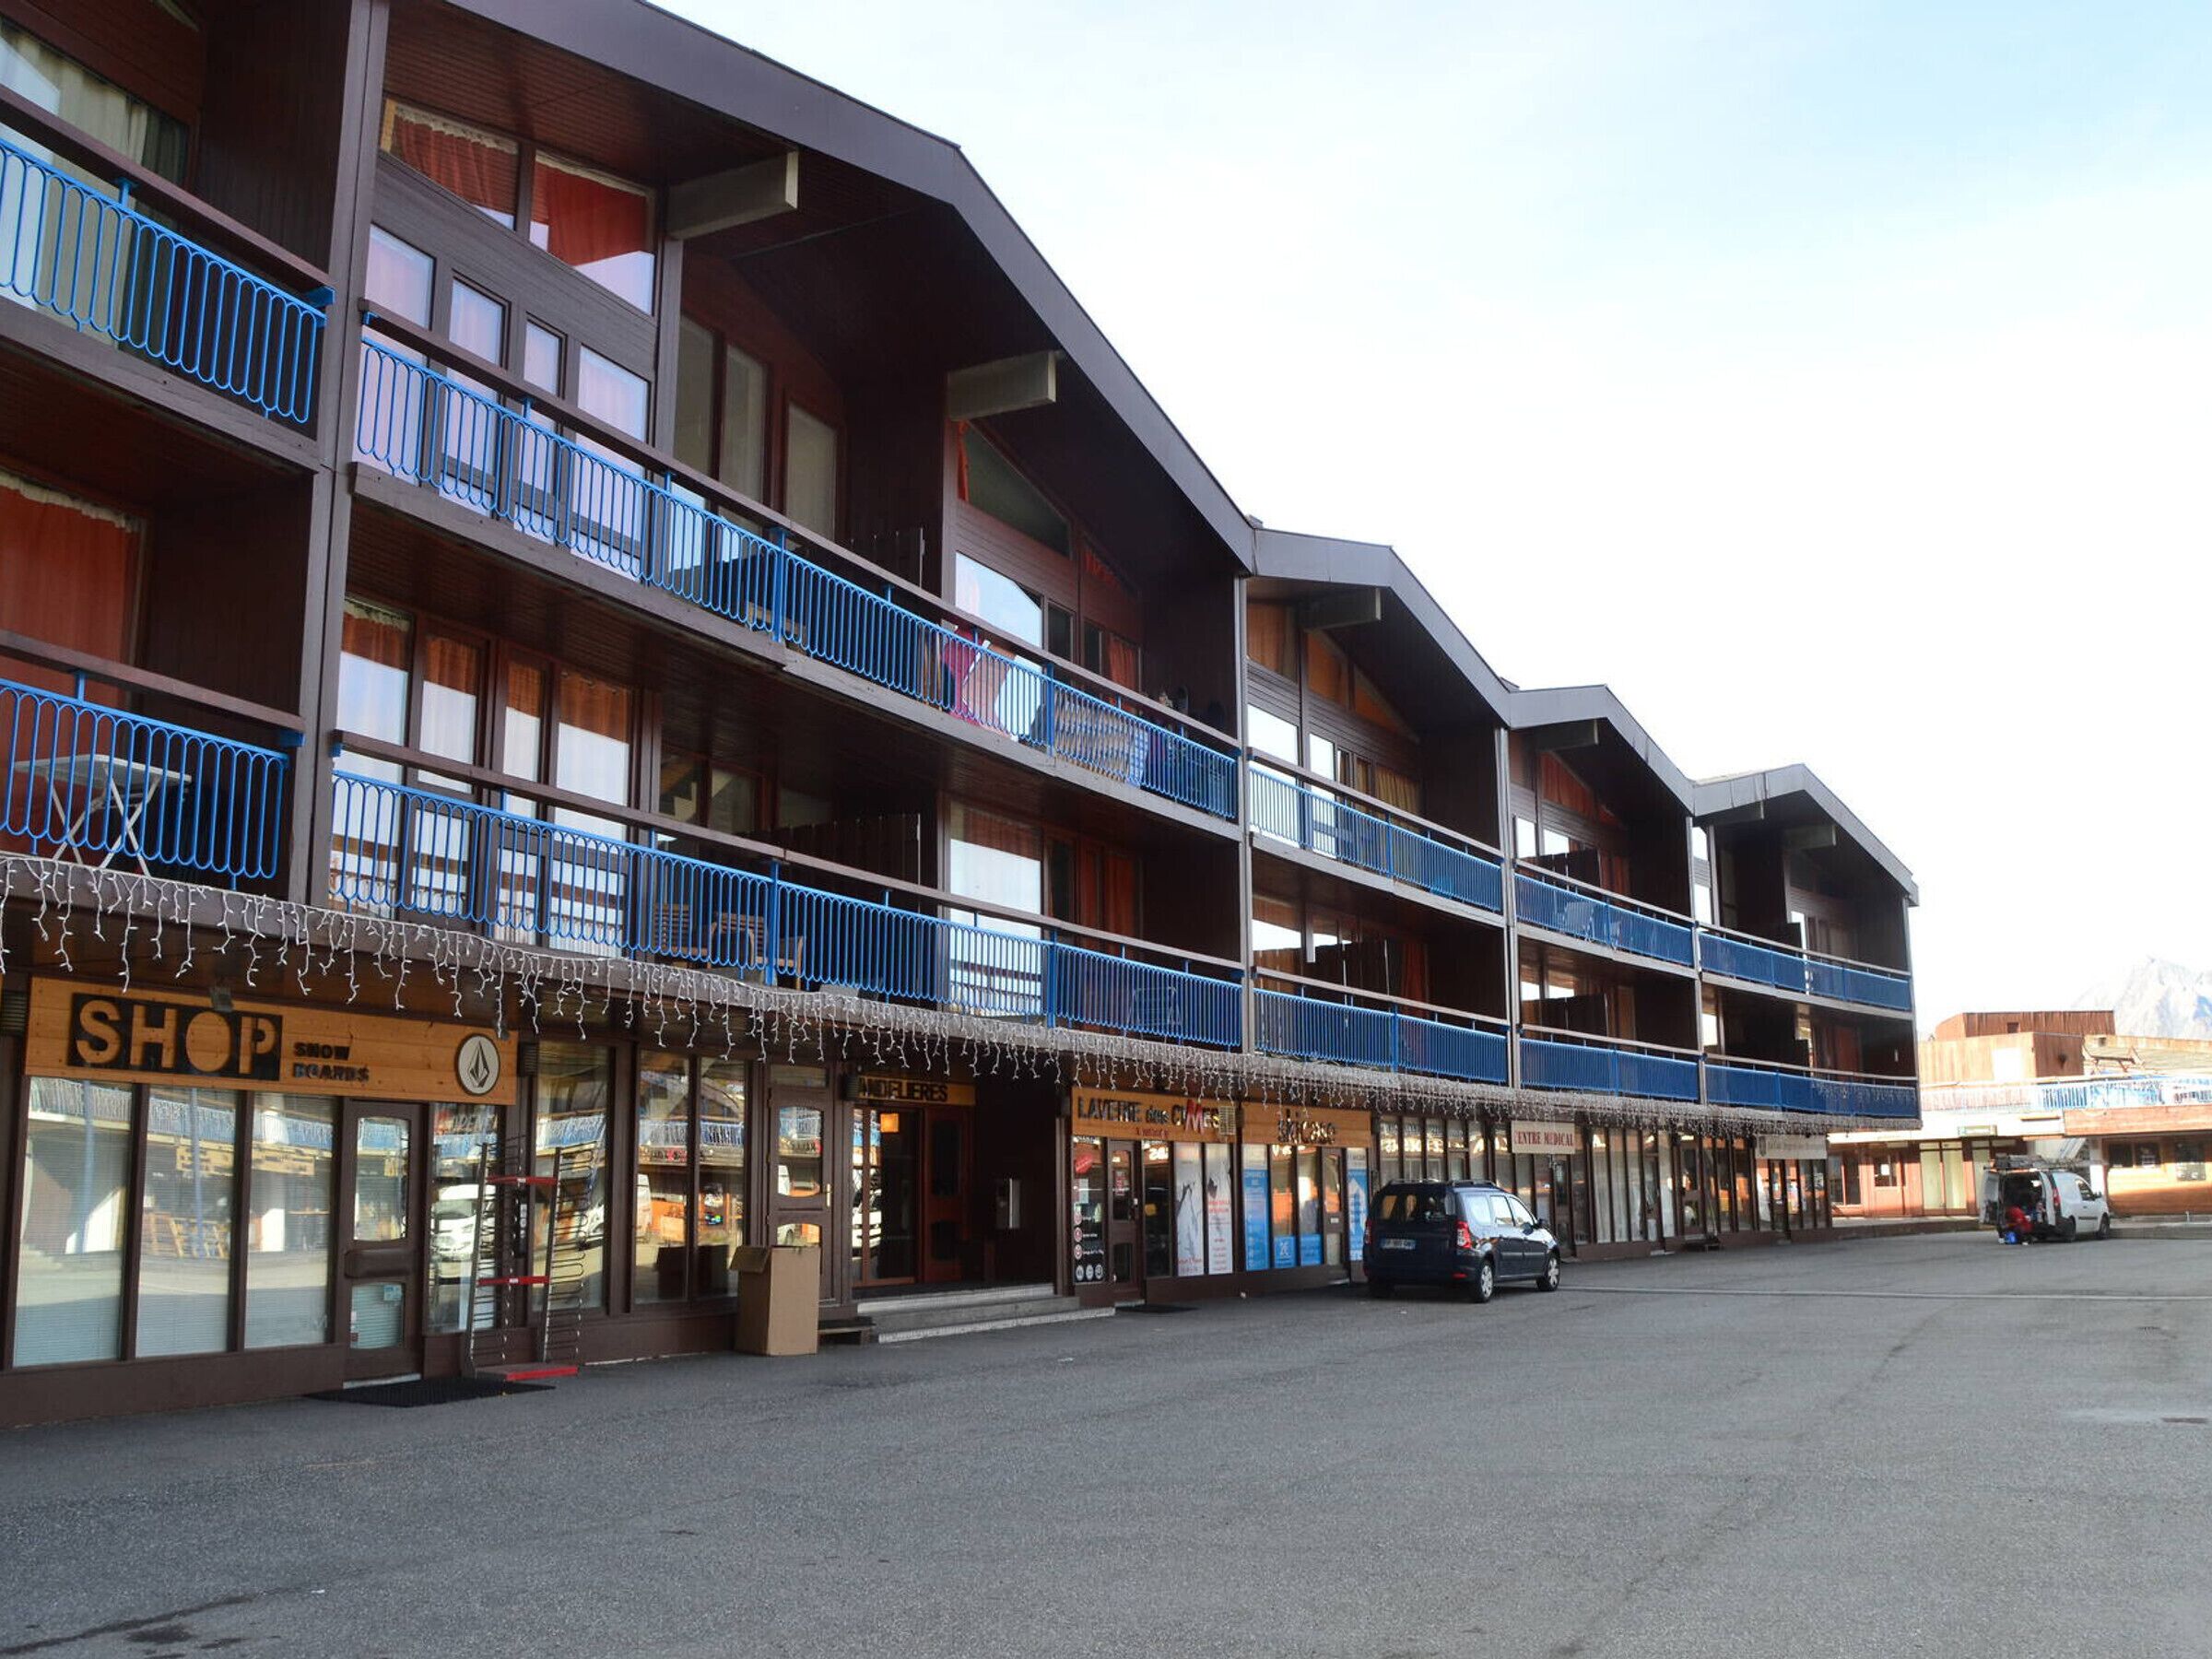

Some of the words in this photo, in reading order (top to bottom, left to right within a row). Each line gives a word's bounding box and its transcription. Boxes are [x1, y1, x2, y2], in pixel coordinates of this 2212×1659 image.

[76, 998, 278, 1076] SHOP
[292, 1041, 351, 1061] SNOW
[291, 1062, 371, 1083] BOARDS
